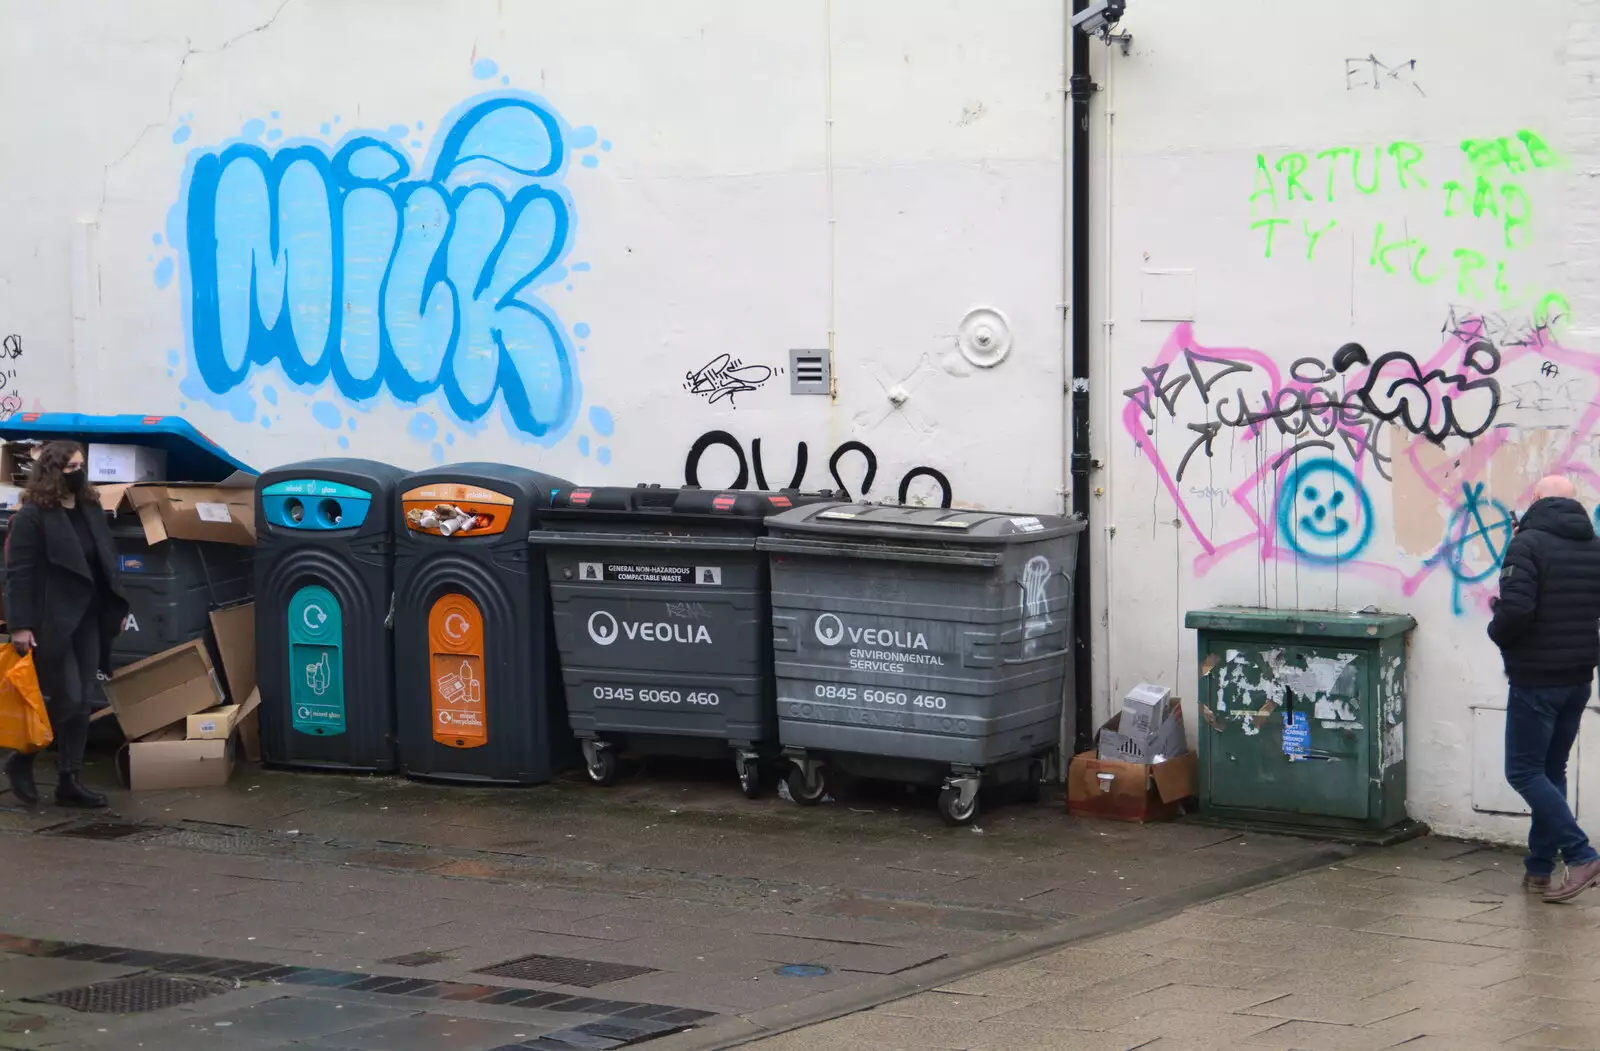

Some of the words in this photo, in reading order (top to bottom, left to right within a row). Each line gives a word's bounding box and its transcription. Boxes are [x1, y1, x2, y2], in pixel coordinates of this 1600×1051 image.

[1249, 141, 1430, 217] ARTUR
[608, 565, 635, 573] GENERAL
[635, 566, 690, 574] NON-HAZARDOUS
[618, 573, 660, 581] COMPACTABLE
[622, 621, 713, 644] VEOLIA
[848, 626, 928, 650] VEOLIA
[850, 648, 945, 666] ENVIRONMENTAL
[850, 659, 905, 673] SERVICES
[593, 686, 634, 701] 0345
[639, 689, 681, 703] 6060
[686, 692, 719, 705] 460
[815, 685, 857, 700] 0845
[863, 689, 907, 705] 6060
[913, 695, 946, 709] 460
